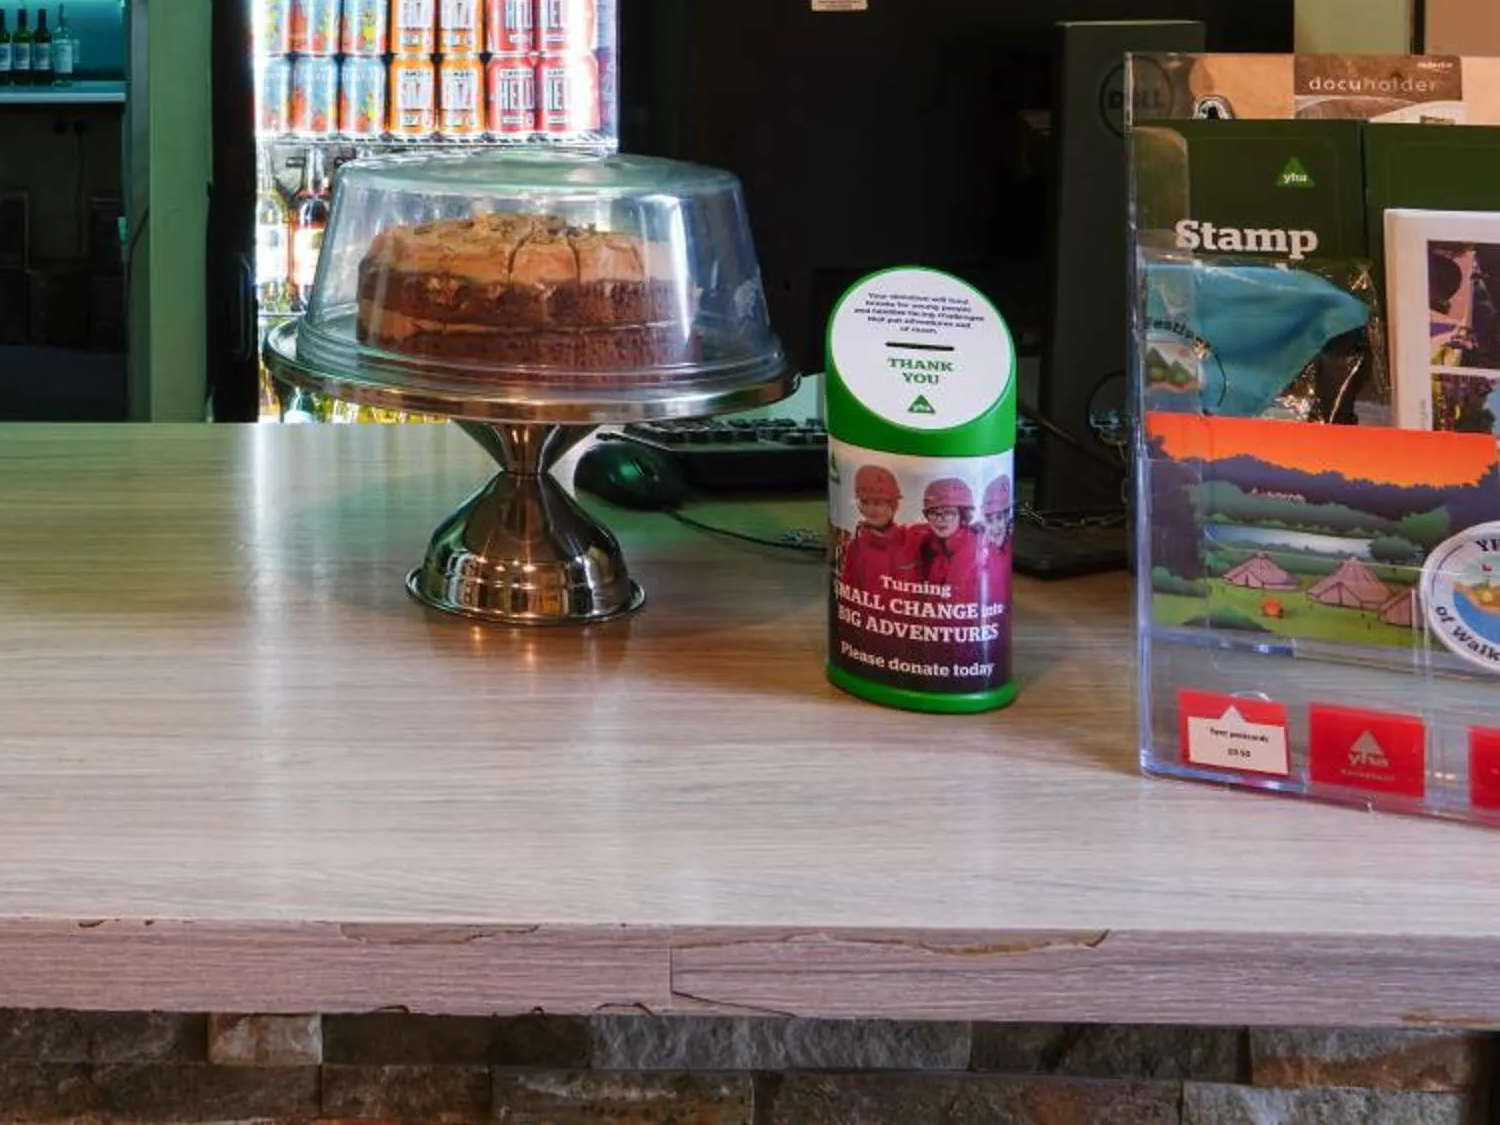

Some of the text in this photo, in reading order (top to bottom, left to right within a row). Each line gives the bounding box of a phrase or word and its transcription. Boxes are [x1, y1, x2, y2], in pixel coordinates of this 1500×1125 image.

[1308, 76, 1438, 93] docuholder
[1283, 172, 1308, 184] yha
[1175, 219, 1319, 260] Stamp
[887, 357, 954, 372] THANK
[902, 372, 940, 385] YOU
[879, 574, 953, 598] Turning
[889, 597, 980, 619] CHANGE
[1434, 605, 1455, 624] of
[865, 615, 1000, 644] ADVENTURES
[840, 639, 996, 677] Please donate today
